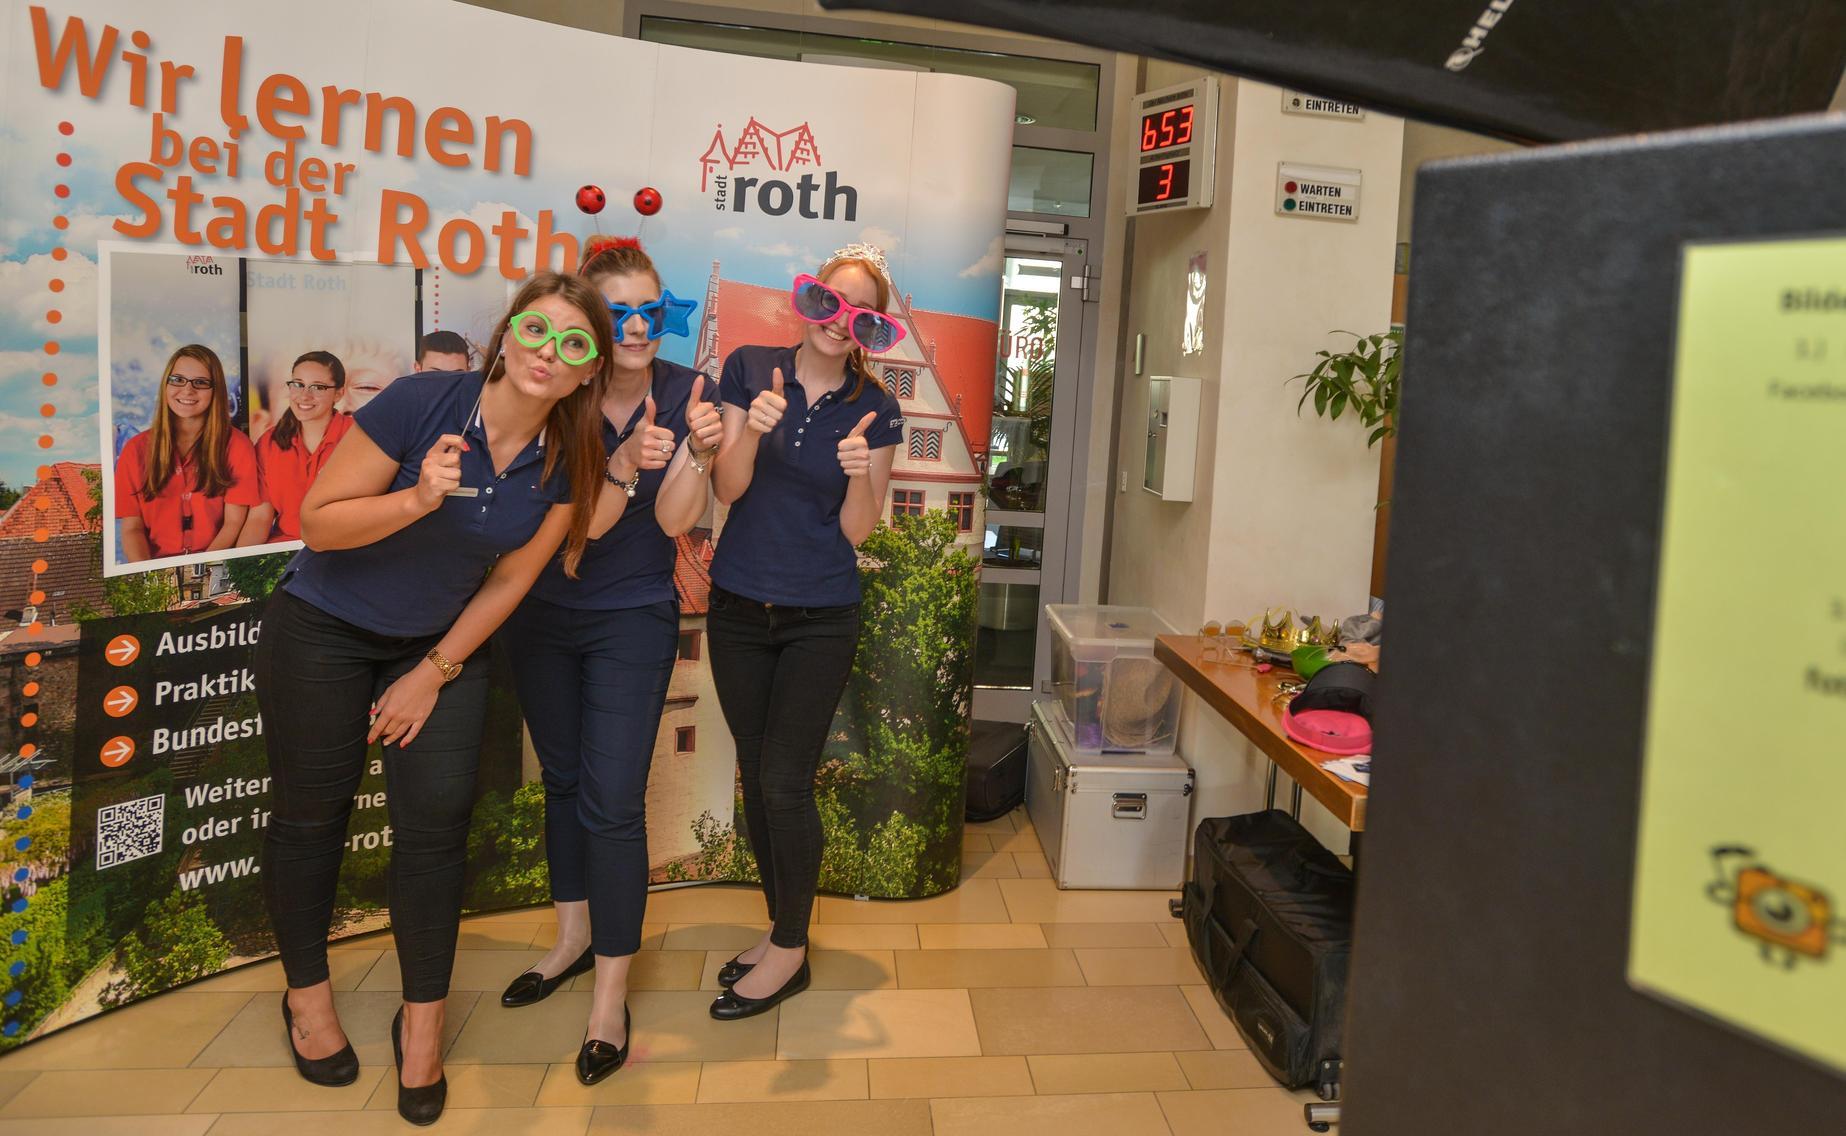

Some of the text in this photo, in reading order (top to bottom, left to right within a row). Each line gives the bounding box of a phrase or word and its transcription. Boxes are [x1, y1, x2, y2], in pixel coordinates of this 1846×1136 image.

[29, 6, 533, 177] Wir lernen
[1305, 99, 1360, 115] EINTRETEN
[1142, 106, 1194, 151] 653
[150, 112, 356, 196] bei der
[714, 174, 728, 211] stadt
[732, 170, 858, 222] roth
[1156, 164, 1174, 200] 3
[1300, 183, 1342, 198] WARTEN
[112, 161, 579, 281] Stadt Roth
[1298, 200, 1353, 216] EINTRETEN
[193, 263, 223, 276] roth
[247, 270, 347, 292] Stadt Roth
[155, 669, 256, 705] Praktik
[185, 776, 272, 808] Weiter
[182, 817, 241, 846] oder
[179, 857, 261, 891] www.
